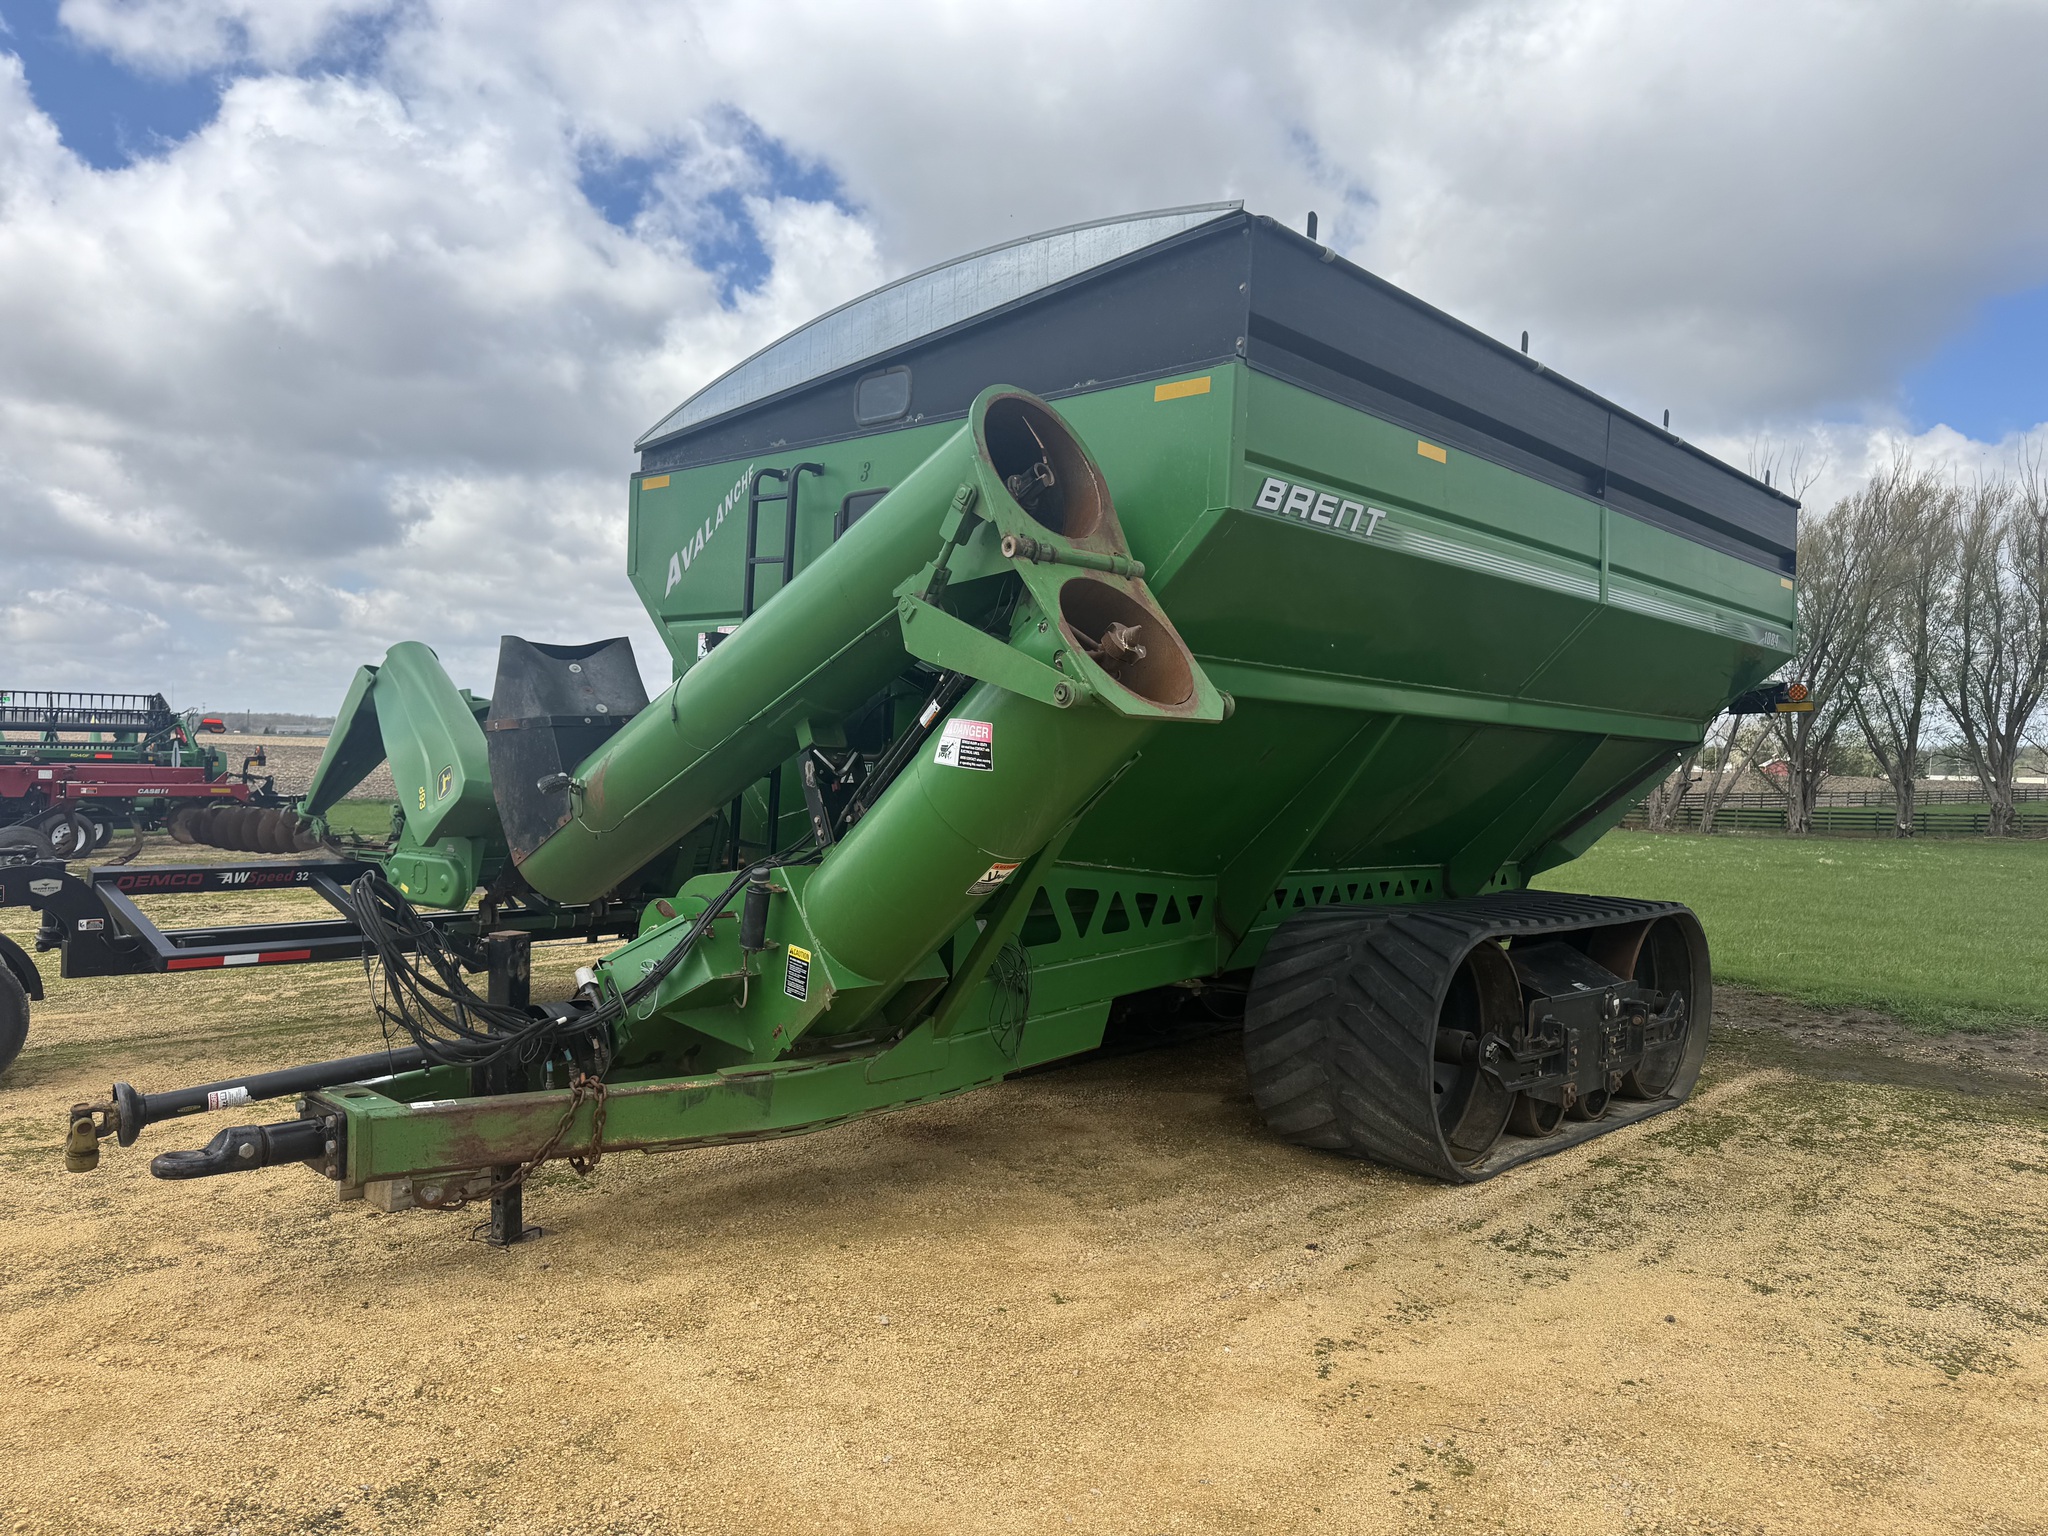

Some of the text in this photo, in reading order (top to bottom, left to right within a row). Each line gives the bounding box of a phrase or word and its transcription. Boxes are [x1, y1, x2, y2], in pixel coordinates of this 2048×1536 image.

[860, 461, 871, 482] 3
[1255, 477, 1387, 537] BRENT
[664, 464, 754, 600] AVALANCHE
[952, 722, 989, 739] DANGER
[116, 873, 203, 889] DEMCO
[793, 948, 810, 961] CAUTION
